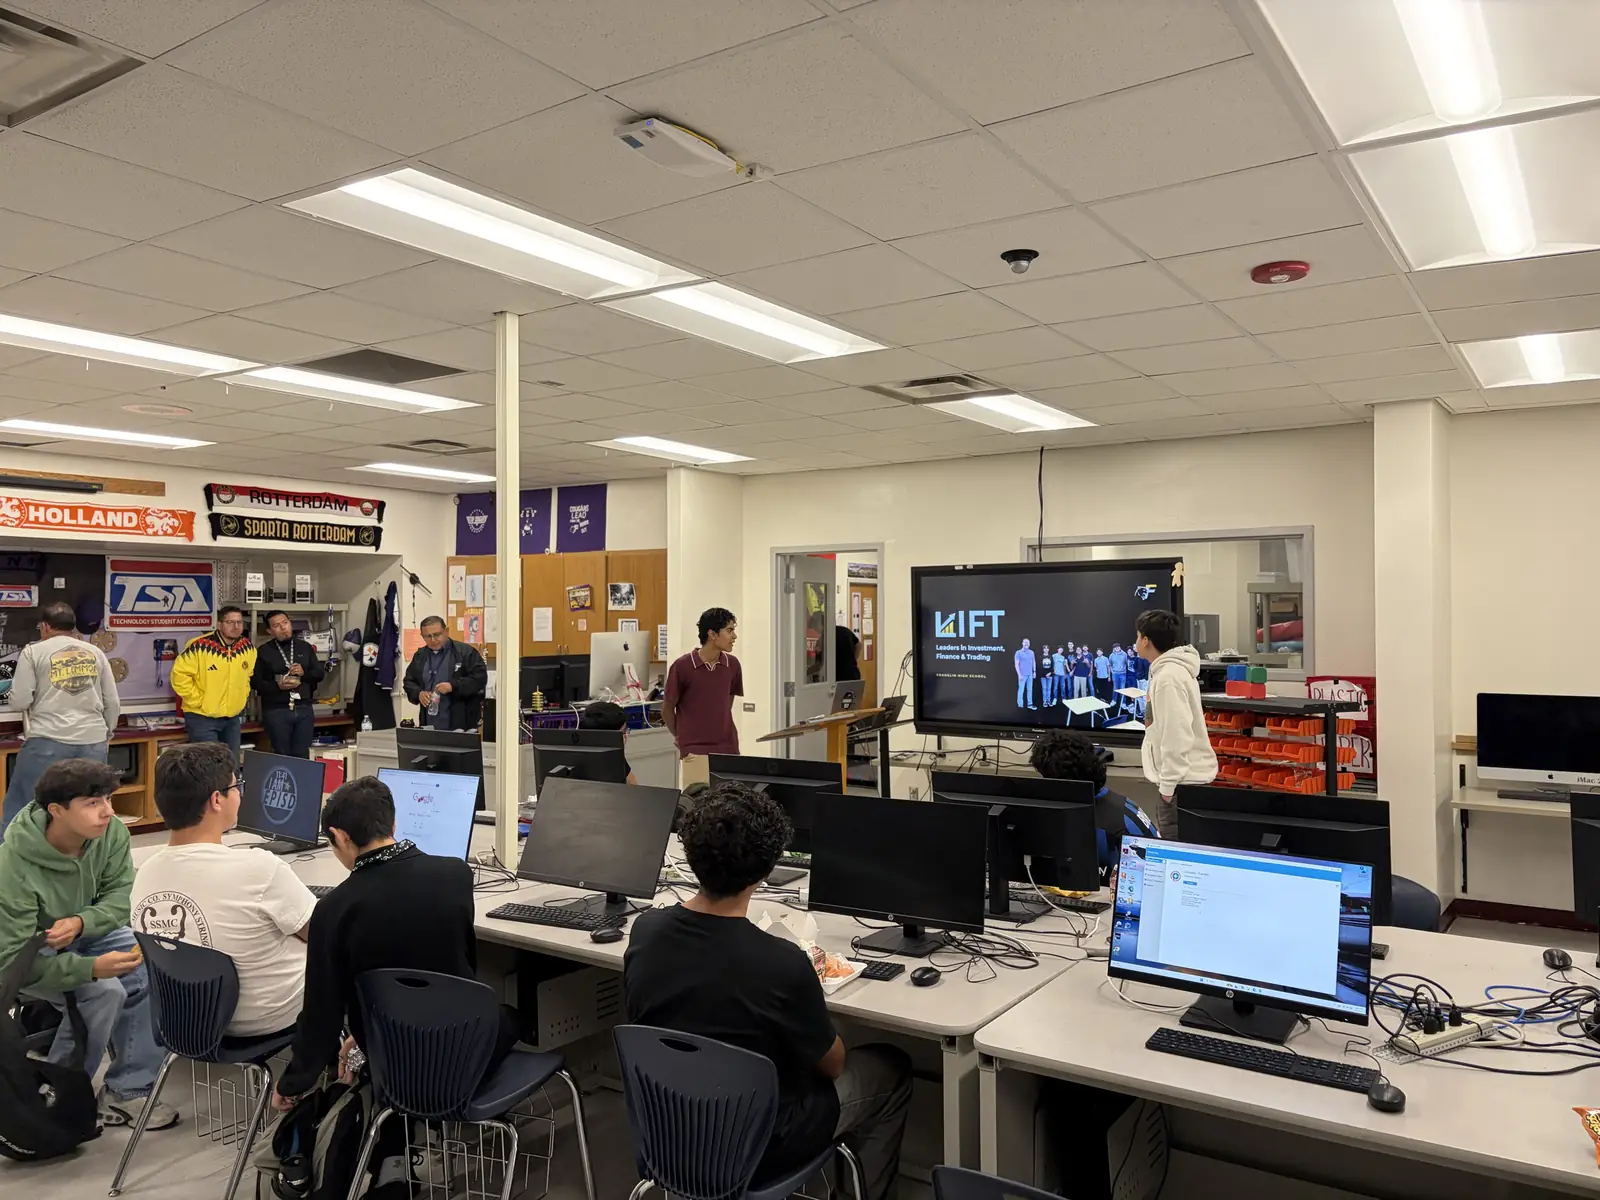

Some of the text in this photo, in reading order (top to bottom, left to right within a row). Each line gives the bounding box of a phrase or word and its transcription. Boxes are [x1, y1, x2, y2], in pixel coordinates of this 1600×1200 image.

[249, 489, 349, 512] ROTTERDAM
[28, 505, 138, 528] HOLLAND
[244, 518, 356, 544] SPARTA ROTTERDAM
[114, 576, 211, 612] TSA
[935, 610, 1006, 638] LIFT
[966, 654, 991, 662] Trading
[968, 645, 1006, 653] Investment,
[1577, 776, 1595, 784] iMac
[264, 790, 296, 809] EPISD
[147, 894, 160, 904] CO.
[162, 893, 200, 917] SYMPHONY
[149, 918, 178, 929] SSMC
